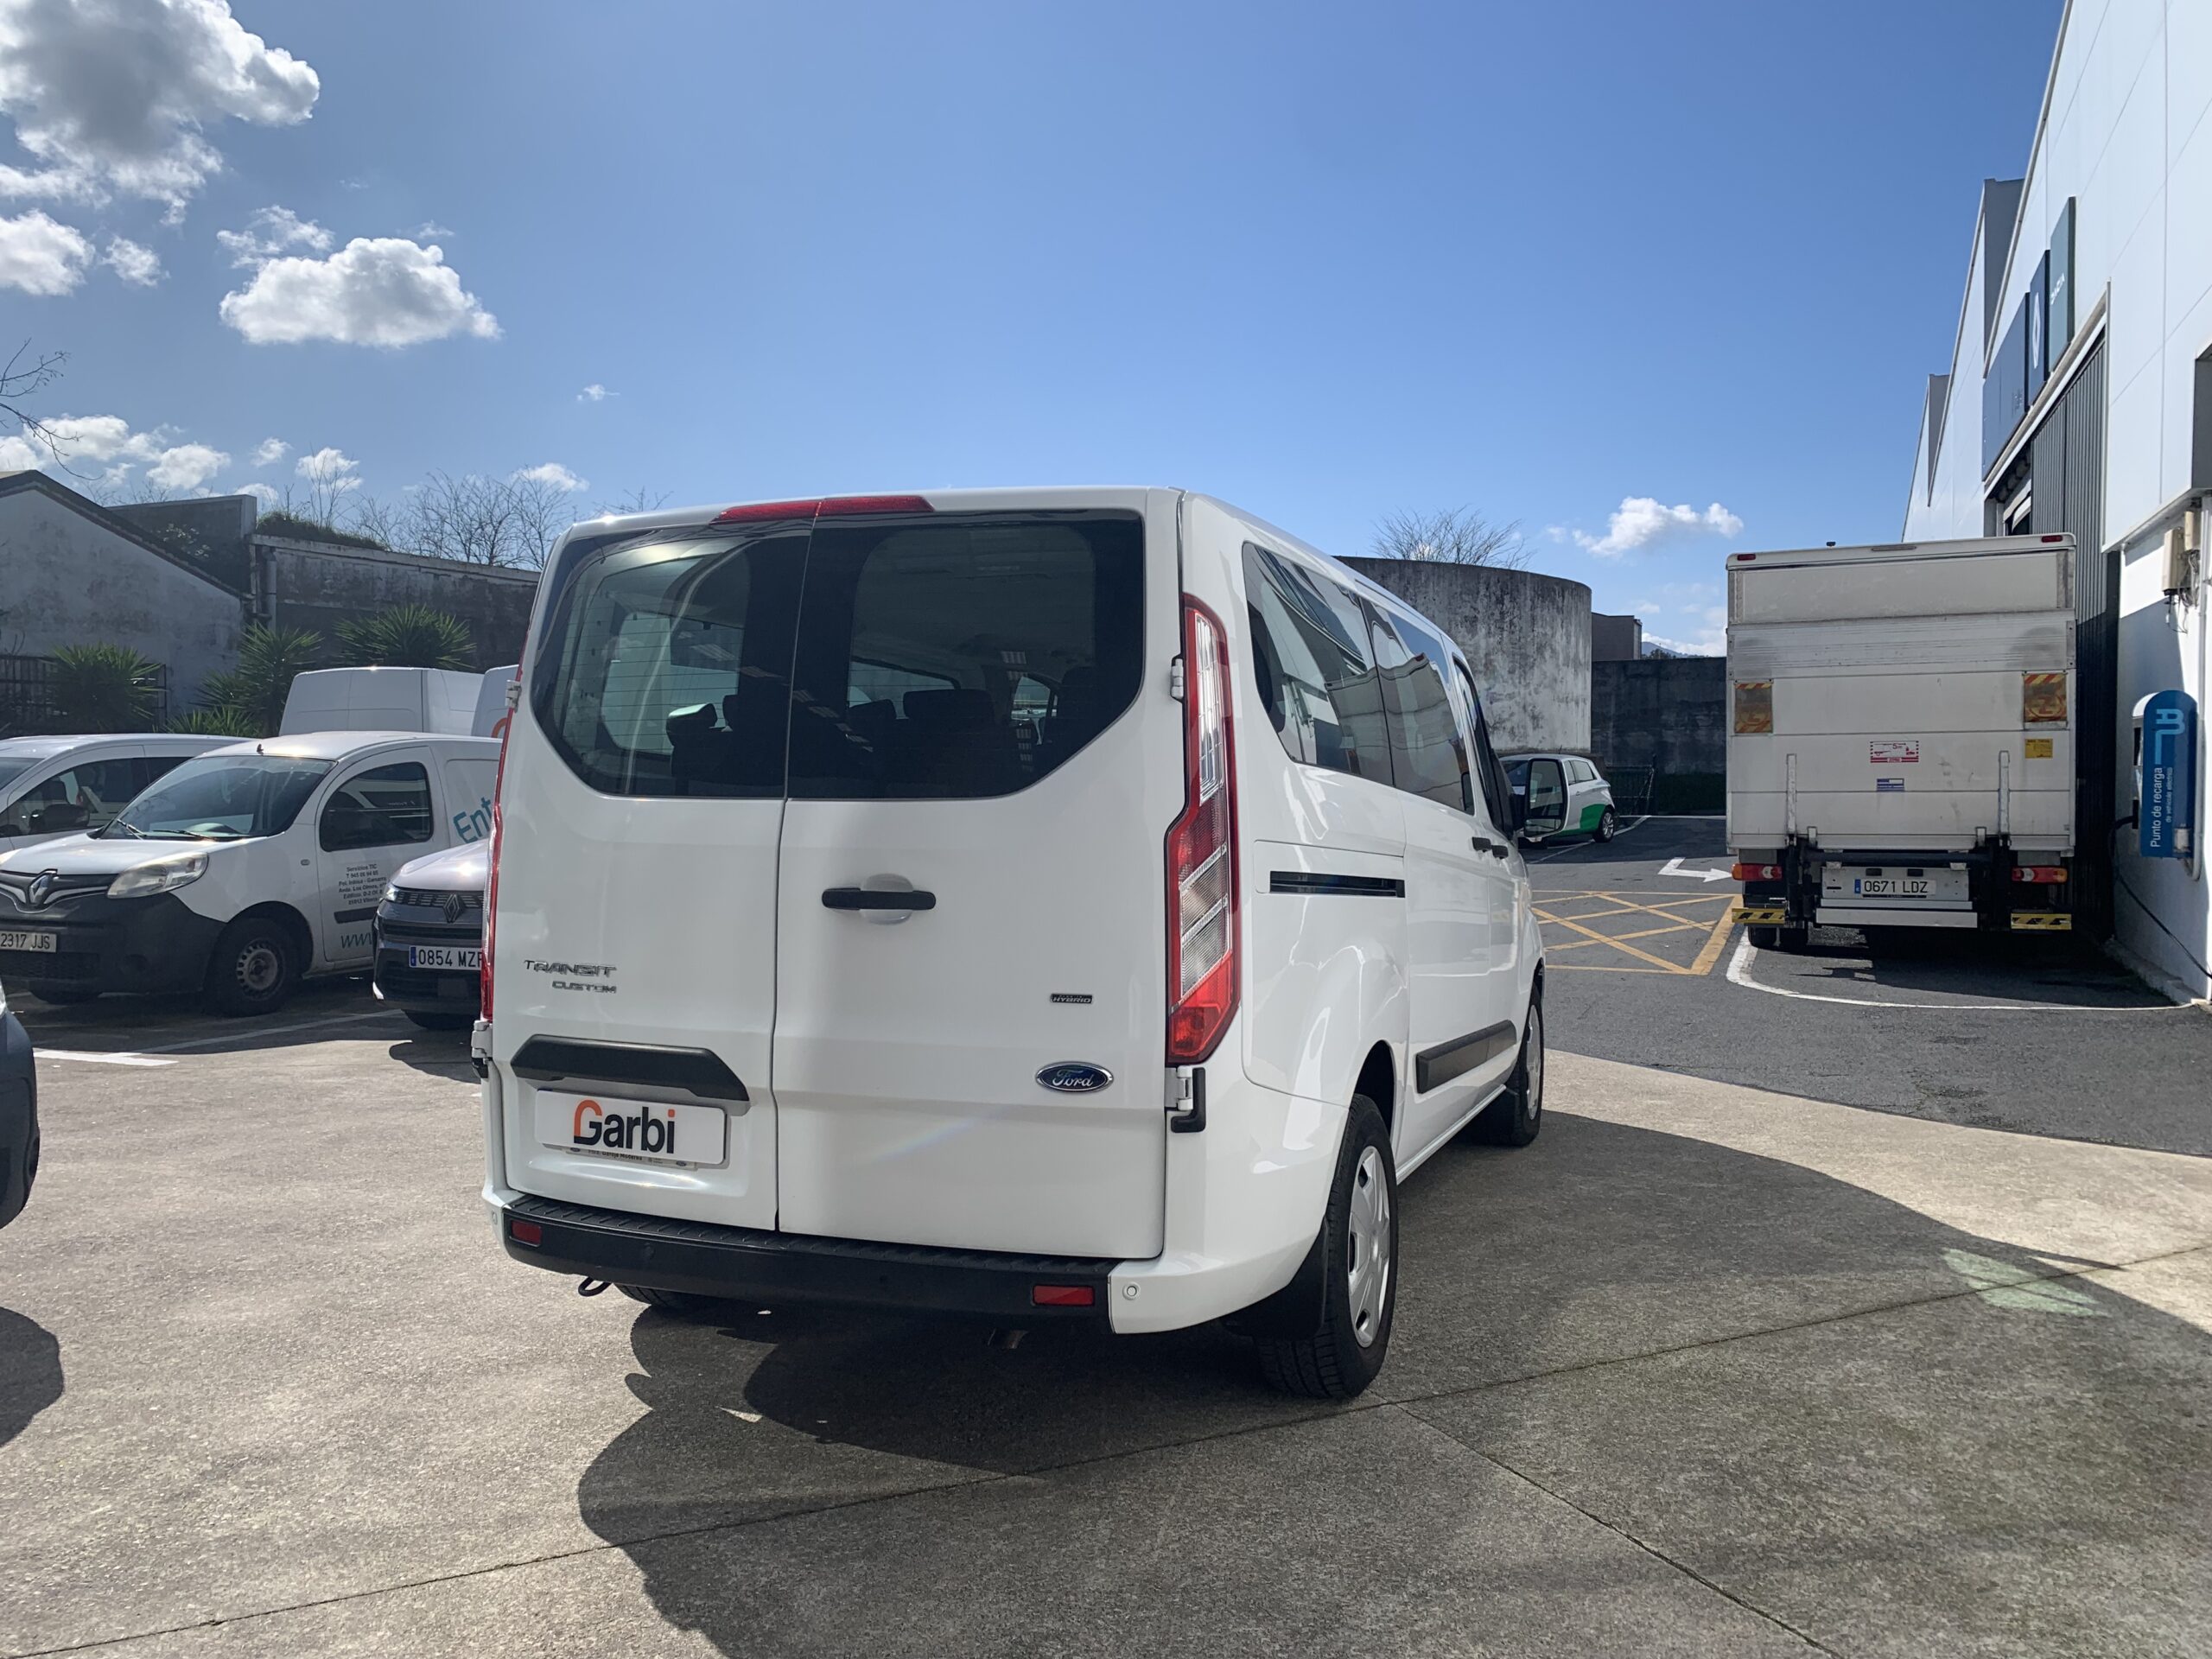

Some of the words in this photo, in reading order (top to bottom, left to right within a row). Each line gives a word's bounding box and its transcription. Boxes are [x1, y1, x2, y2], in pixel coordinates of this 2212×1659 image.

[2152, 767, 2165, 804] recarga
[2151, 805, 2162, 817] de
[2150, 819, 2162, 848] Punto
[1864, 880, 1896, 893] 0671
[1903, 880, 1929, 893] LDZ
[0, 933, 27, 948] 2317
[31, 934, 50, 950] JJS
[418, 949, 454, 966] 0854
[524, 959, 618, 977] TRANSIT
[551, 981, 617, 994] CUSTOM
[1052, 1069, 1095, 1087] Ford
[573, 1099, 676, 1154] Garbi
